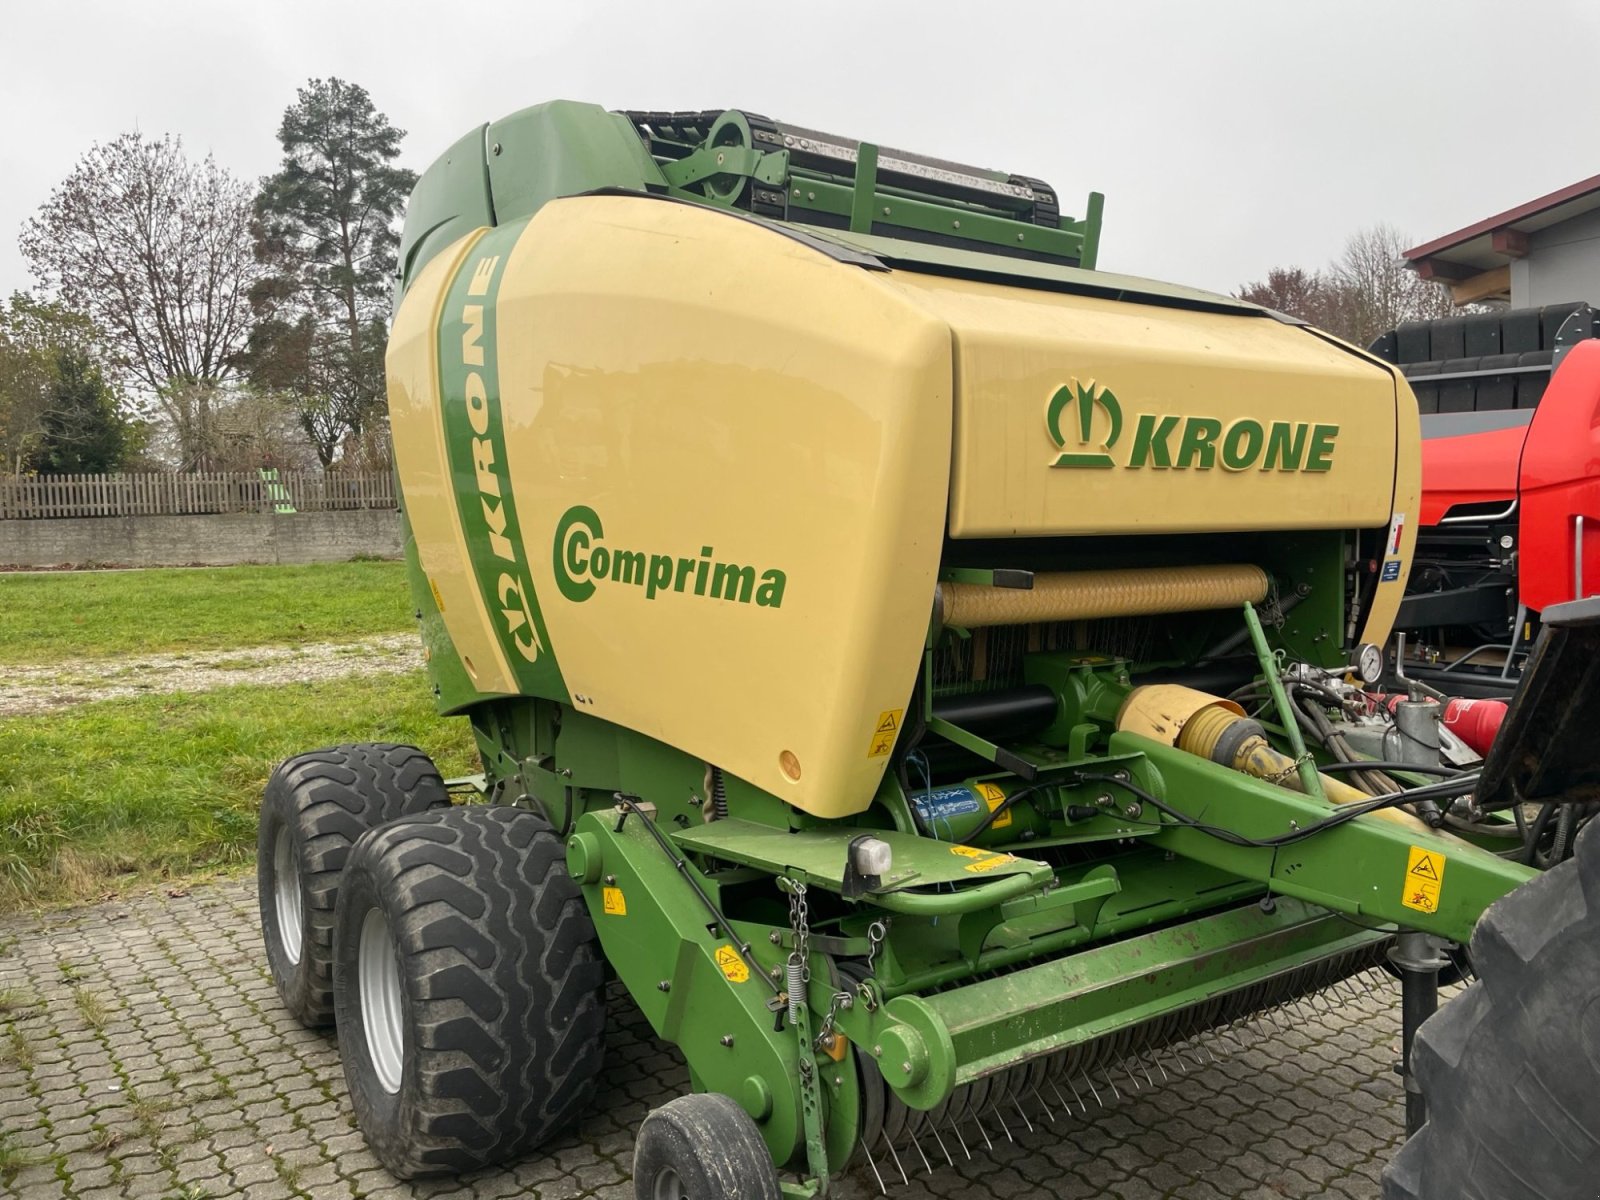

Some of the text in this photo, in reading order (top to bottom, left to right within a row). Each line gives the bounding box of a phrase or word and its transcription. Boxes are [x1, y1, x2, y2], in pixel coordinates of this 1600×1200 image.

[462, 255, 516, 563] KRONE
[1126, 413, 1340, 472] KRONE
[553, 505, 787, 609] Comprima
